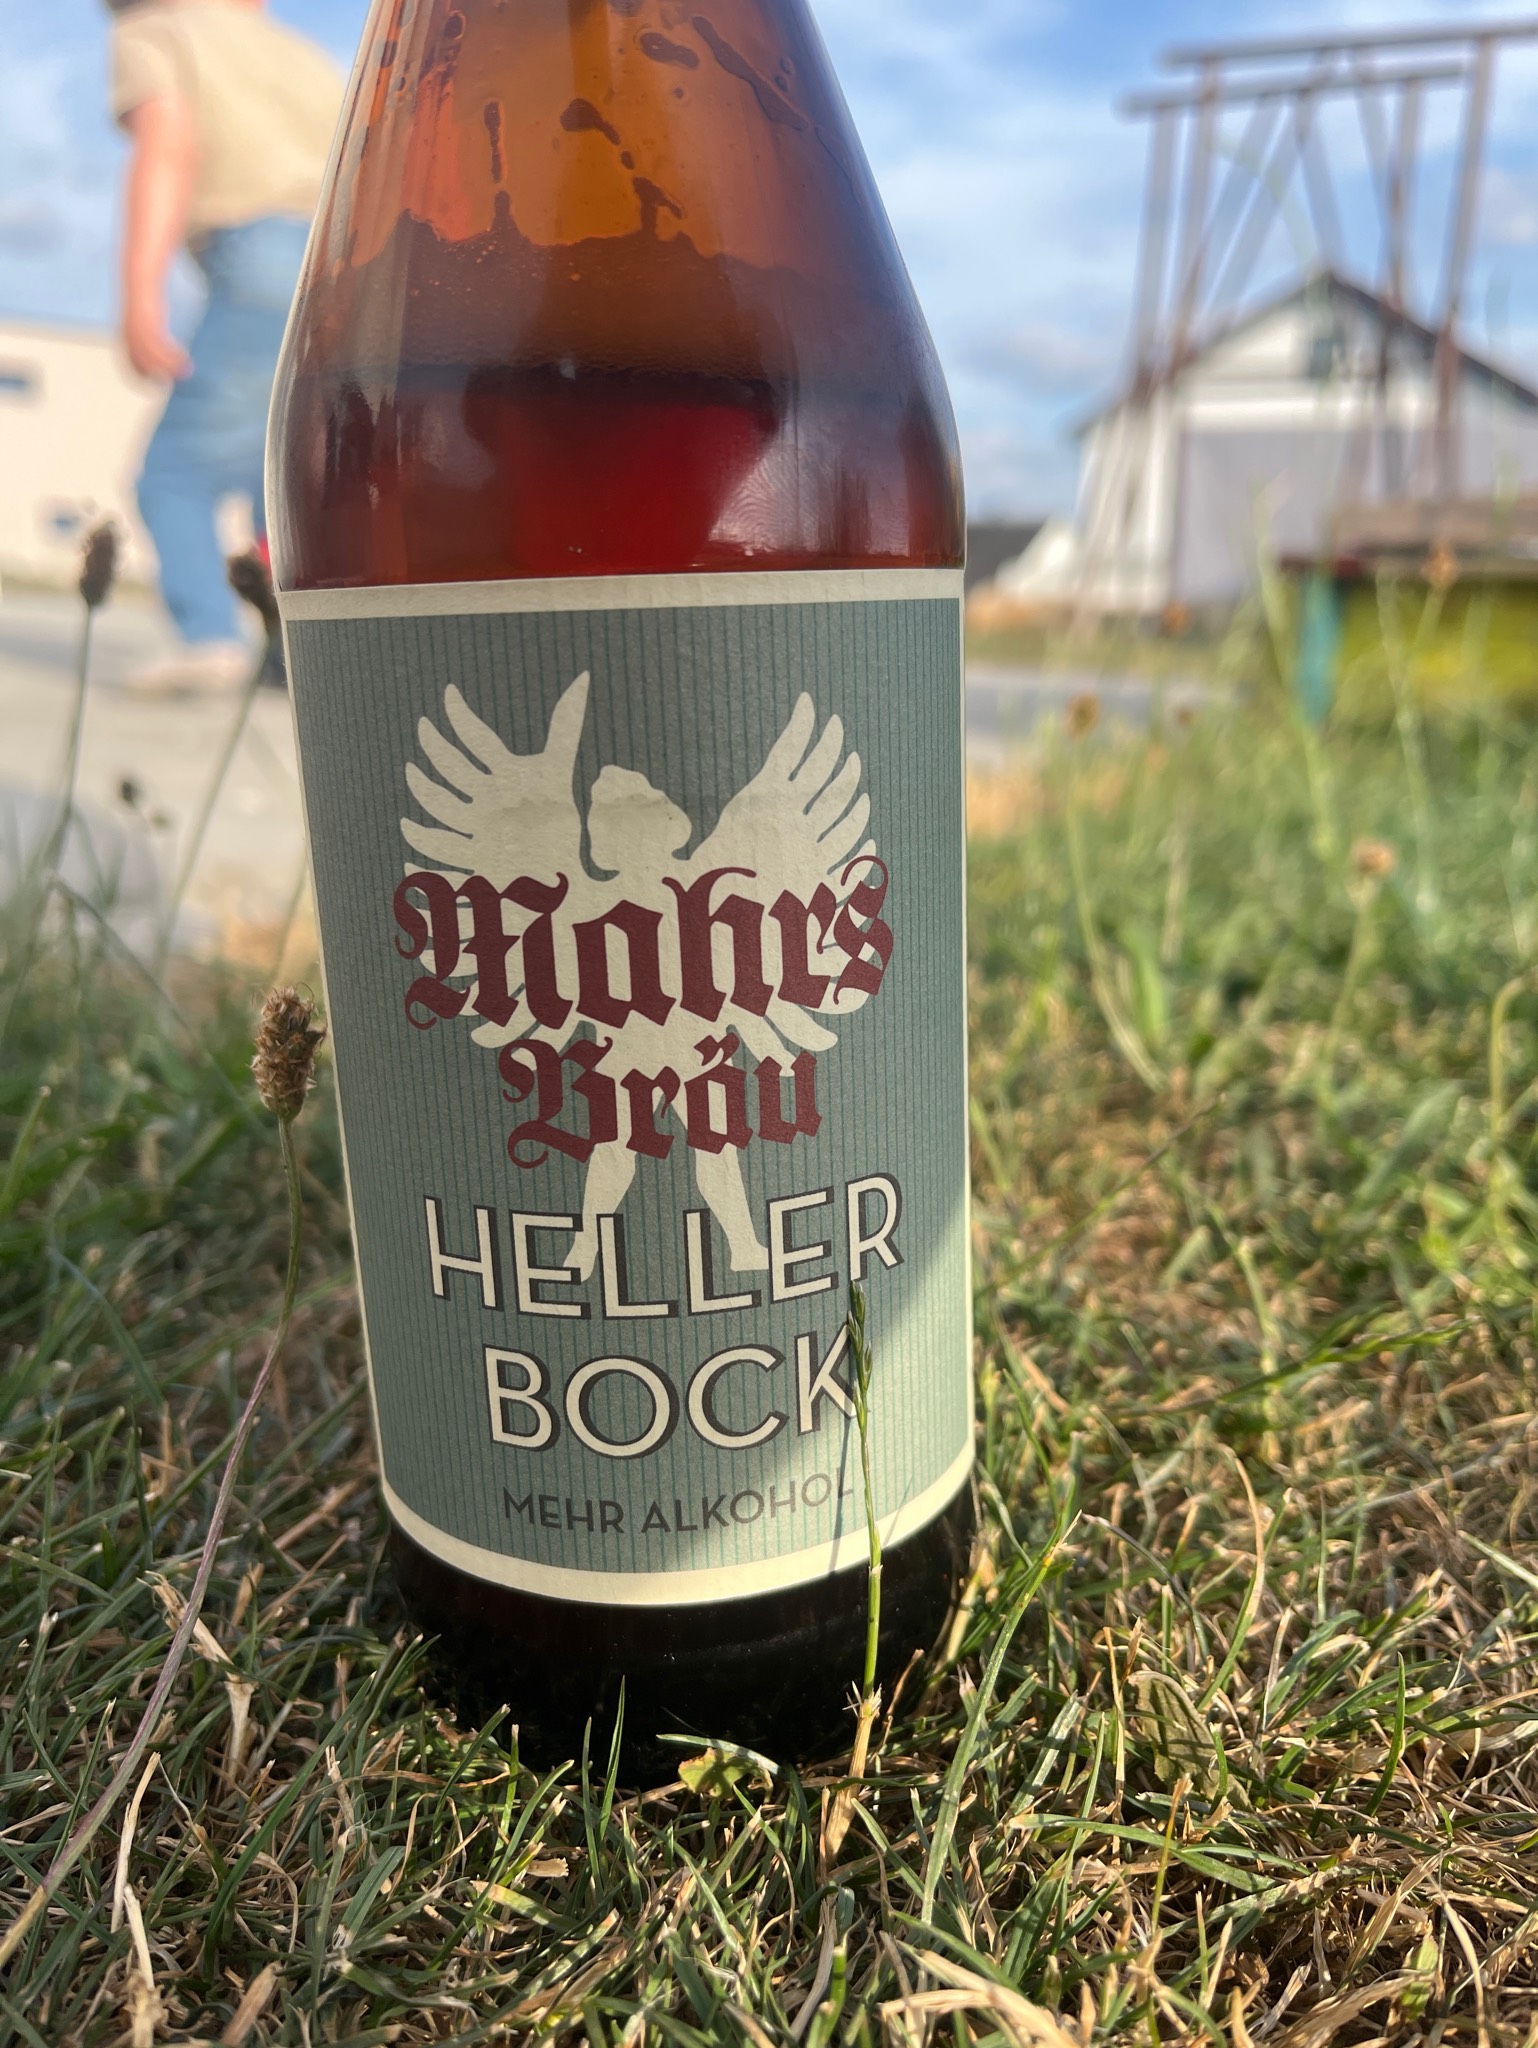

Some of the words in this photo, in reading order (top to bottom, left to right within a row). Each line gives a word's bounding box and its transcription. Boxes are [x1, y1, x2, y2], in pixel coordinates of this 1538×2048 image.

[393, 855, 893, 1030] Mahrs
[500, 1033, 823, 1168] Bräu
[424, 1172, 904, 1320] HELLER
[483, 1322, 868, 1460] BOCK
[503, 1486, 625, 1534] MEHR
[641, 1466, 855, 1535] ALKOHOL
